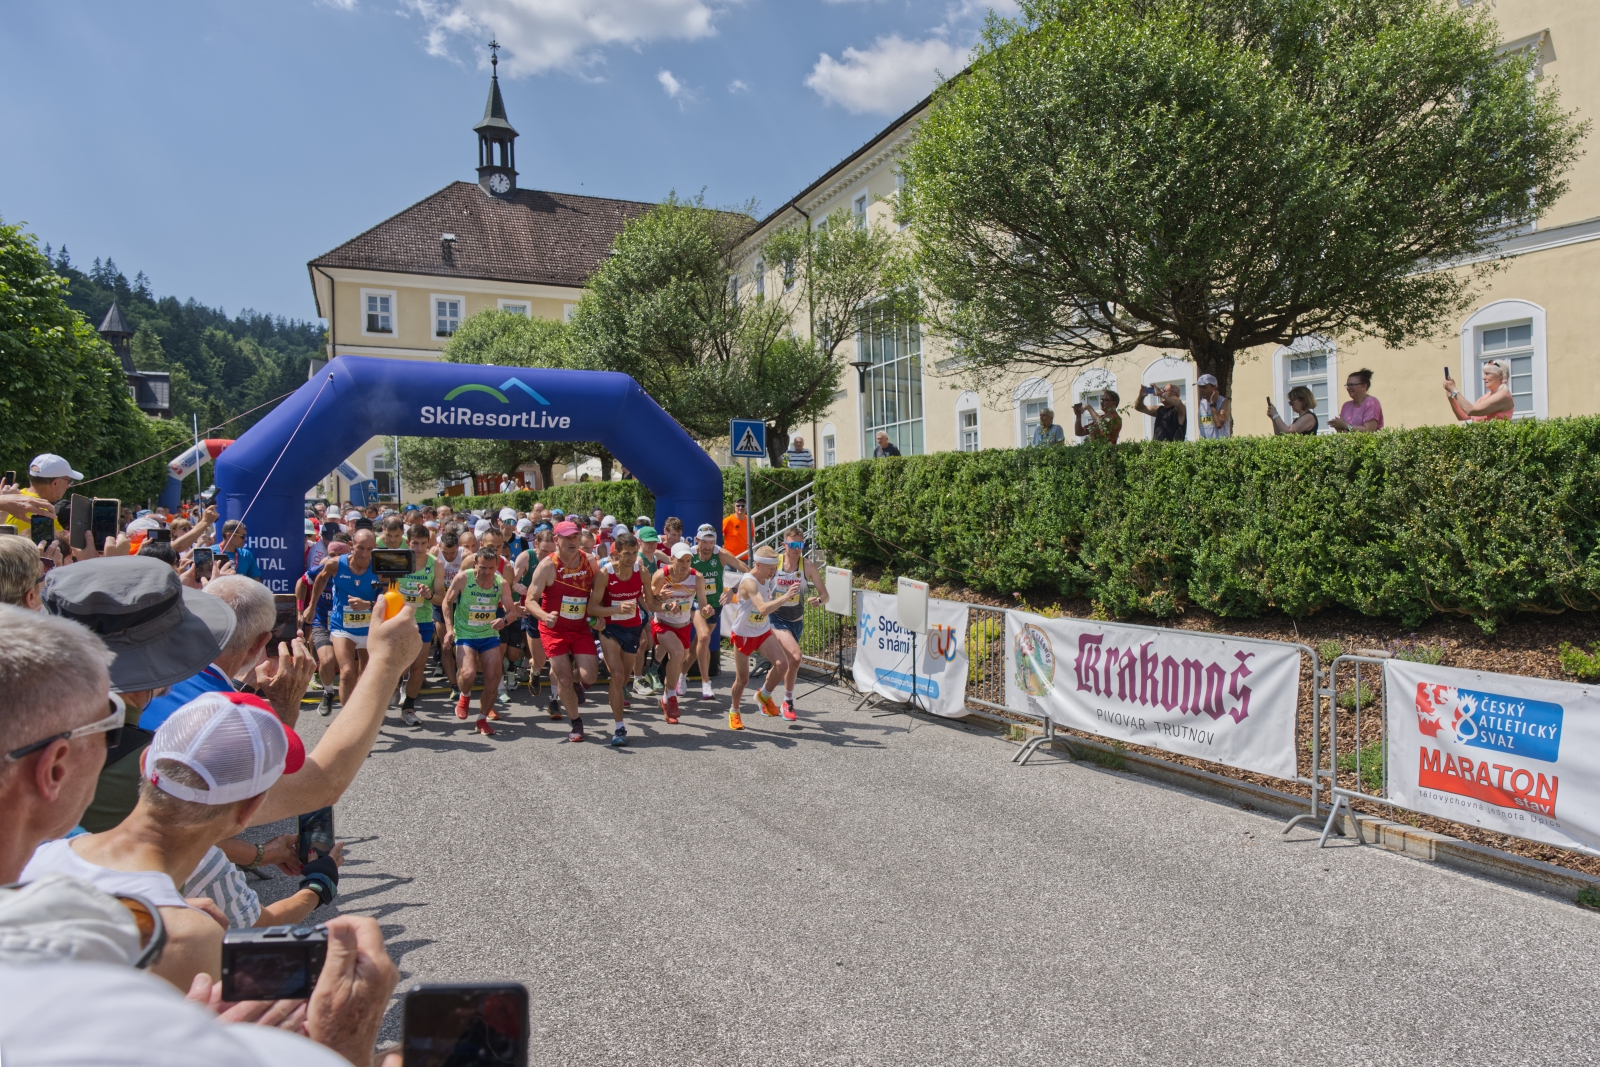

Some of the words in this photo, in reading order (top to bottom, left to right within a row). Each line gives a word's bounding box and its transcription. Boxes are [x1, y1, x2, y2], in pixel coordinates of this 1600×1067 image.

[420, 406, 570, 428] SkiResortLive
[887, 635, 910, 654] námi
[1073, 633, 1256, 725] Krakonoš
[1480, 696, 1526, 718] ČESKÝ
[1096, 708, 1147, 731] PIVOVAR
[1154, 721, 1215, 746] TRUTNOV
[1479, 714, 1558, 740] ATLETICKÝ
[1480, 731, 1515, 749] SVAZ
[1419, 746, 1559, 802] MARATON
[1486, 805, 1525, 821] jednota
[1513, 796, 1551, 814] stav
